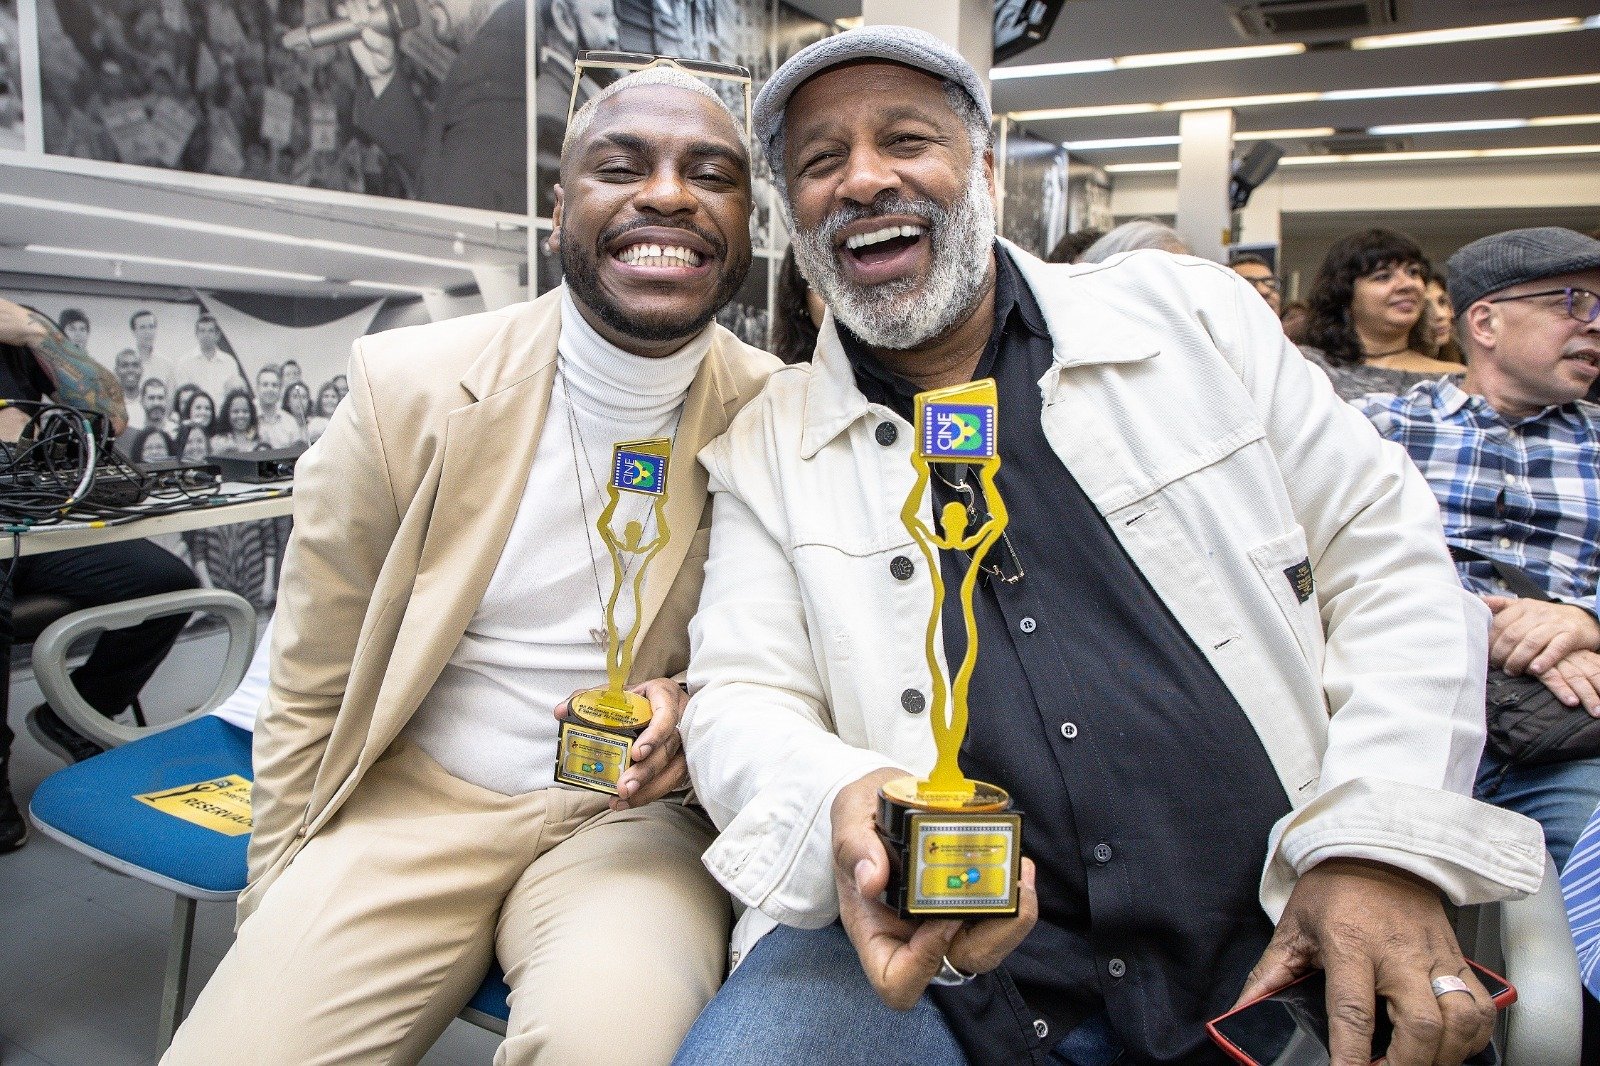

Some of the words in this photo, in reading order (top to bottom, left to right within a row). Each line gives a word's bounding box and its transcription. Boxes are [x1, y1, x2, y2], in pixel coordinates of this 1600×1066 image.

[937, 412, 952, 450] CINE
[622, 458, 635, 485] CINE
[181, 797, 255, 827] RESERVAD
